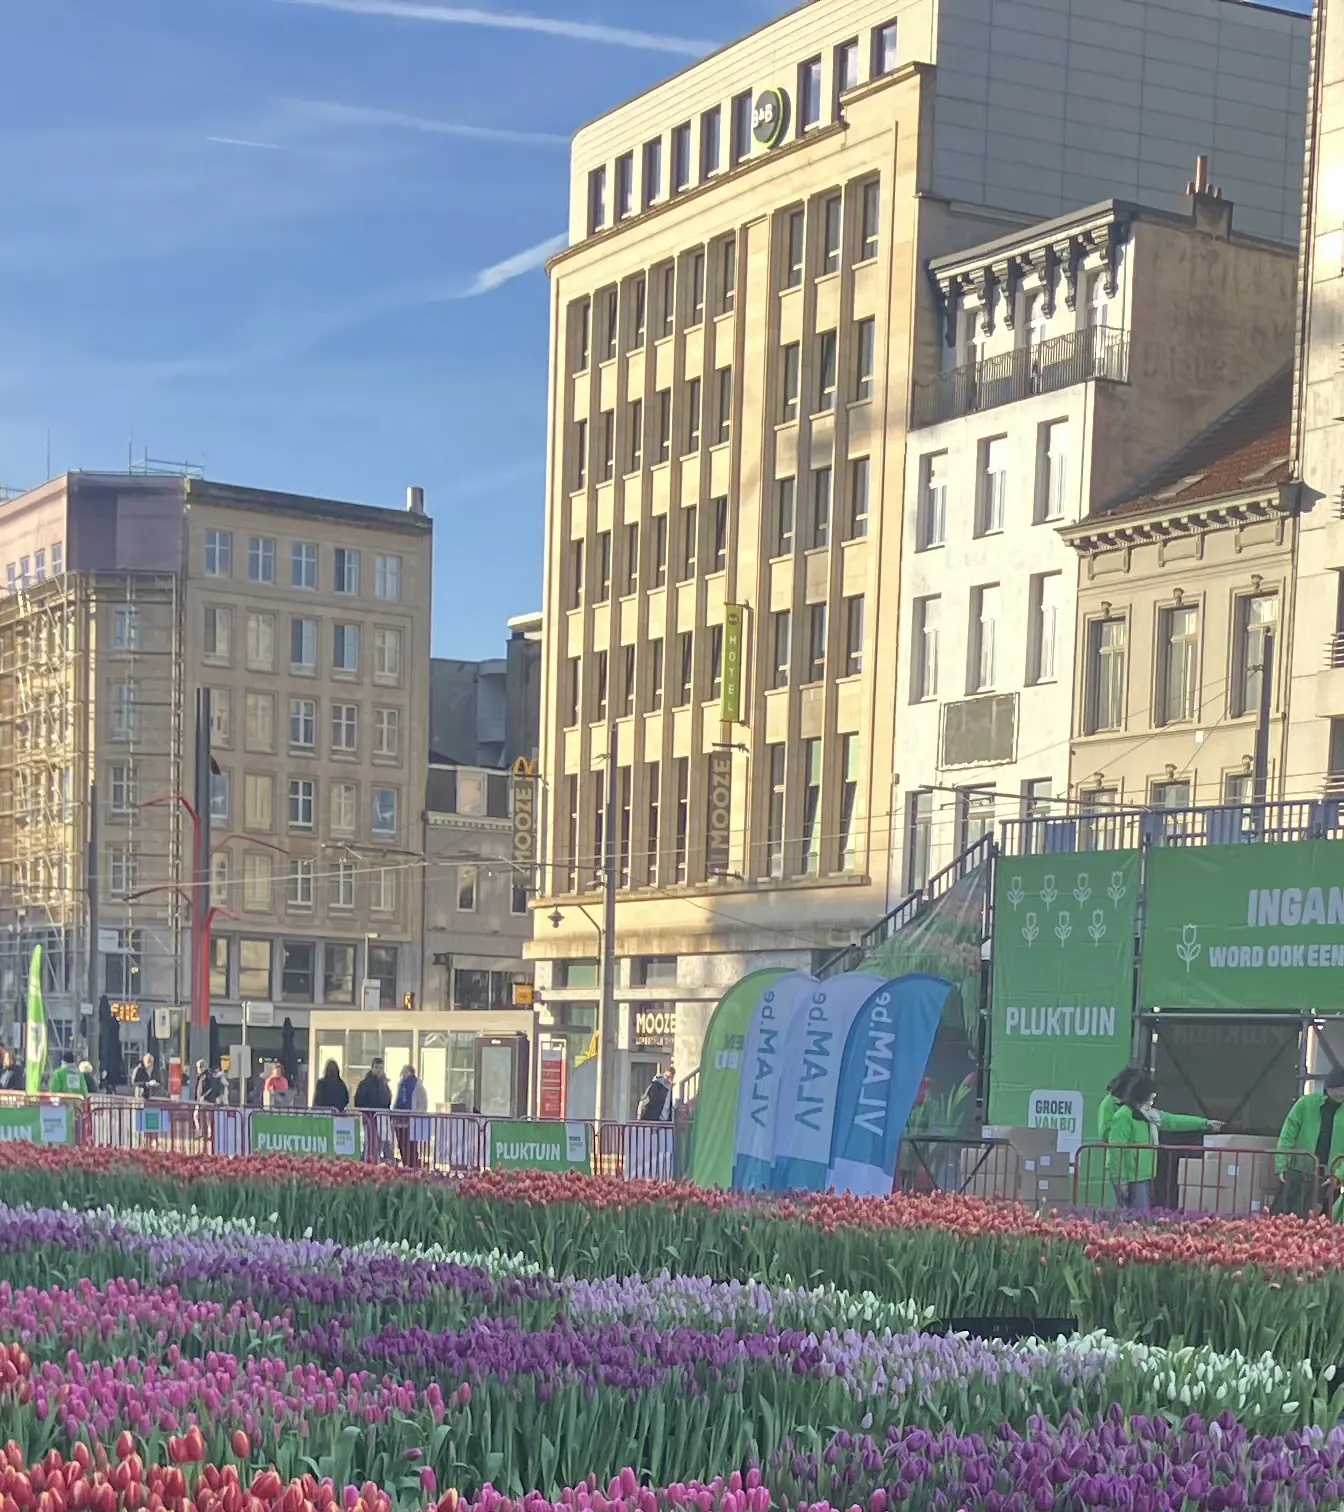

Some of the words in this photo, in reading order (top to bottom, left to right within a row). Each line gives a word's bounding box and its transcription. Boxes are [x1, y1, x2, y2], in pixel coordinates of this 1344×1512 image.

[727, 635, 737, 712] HOTEL
[710, 759, 730, 849] MOOZE
[1209, 945, 1264, 968] WORD
[1267, 945, 1305, 968] OOK
[1307, 944, 1344, 967] EEN
[636, 1013, 676, 1034] MOOZE
[1006, 1006, 1116, 1036] PLUKTUIN
[1035, 1100, 1073, 1115] GROEN
[257, 1132, 328, 1153] PLUKTUIN
[495, 1141, 561, 1161] PLUKTUIN
